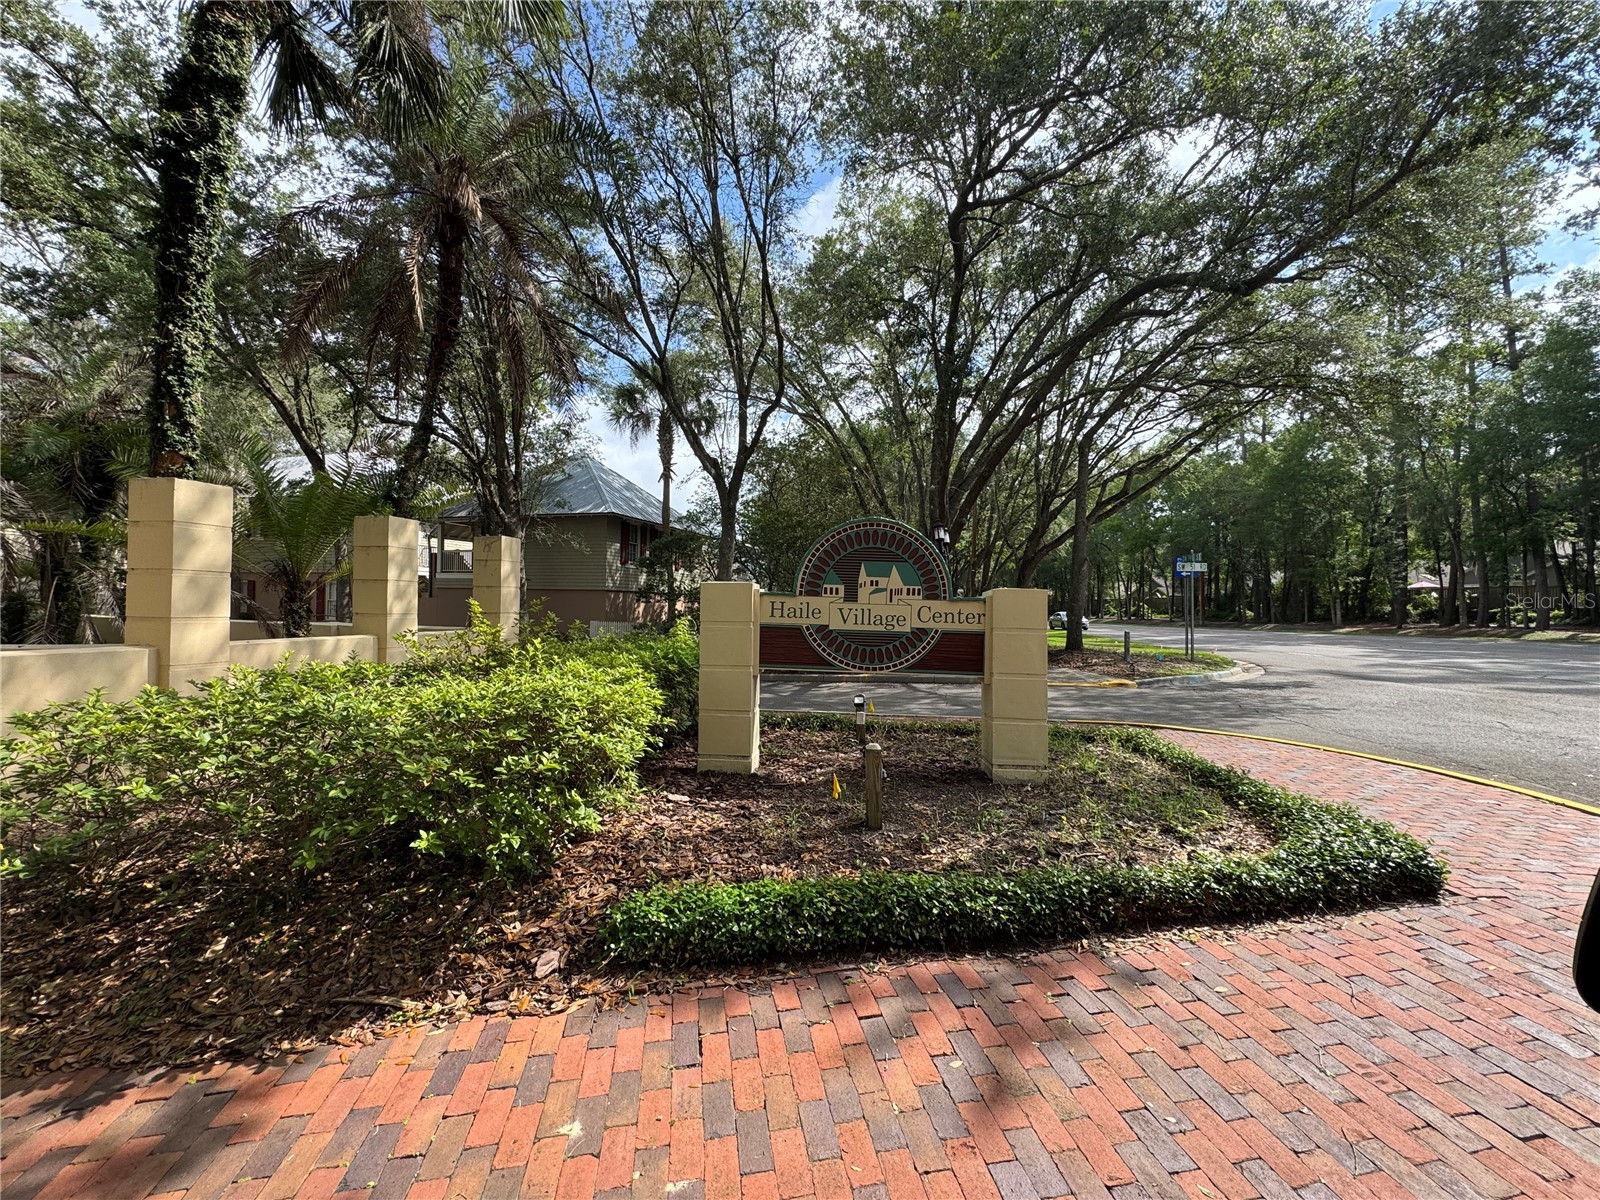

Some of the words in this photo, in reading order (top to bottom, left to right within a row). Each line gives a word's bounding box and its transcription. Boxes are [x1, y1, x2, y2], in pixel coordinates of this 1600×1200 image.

[1177, 563, 1186, 571] SW
[1200, 563, 1207, 571] RD
[769, 601, 822, 619] Haile
[838, 607, 907, 631] Village
[917, 605, 986, 625] Center
